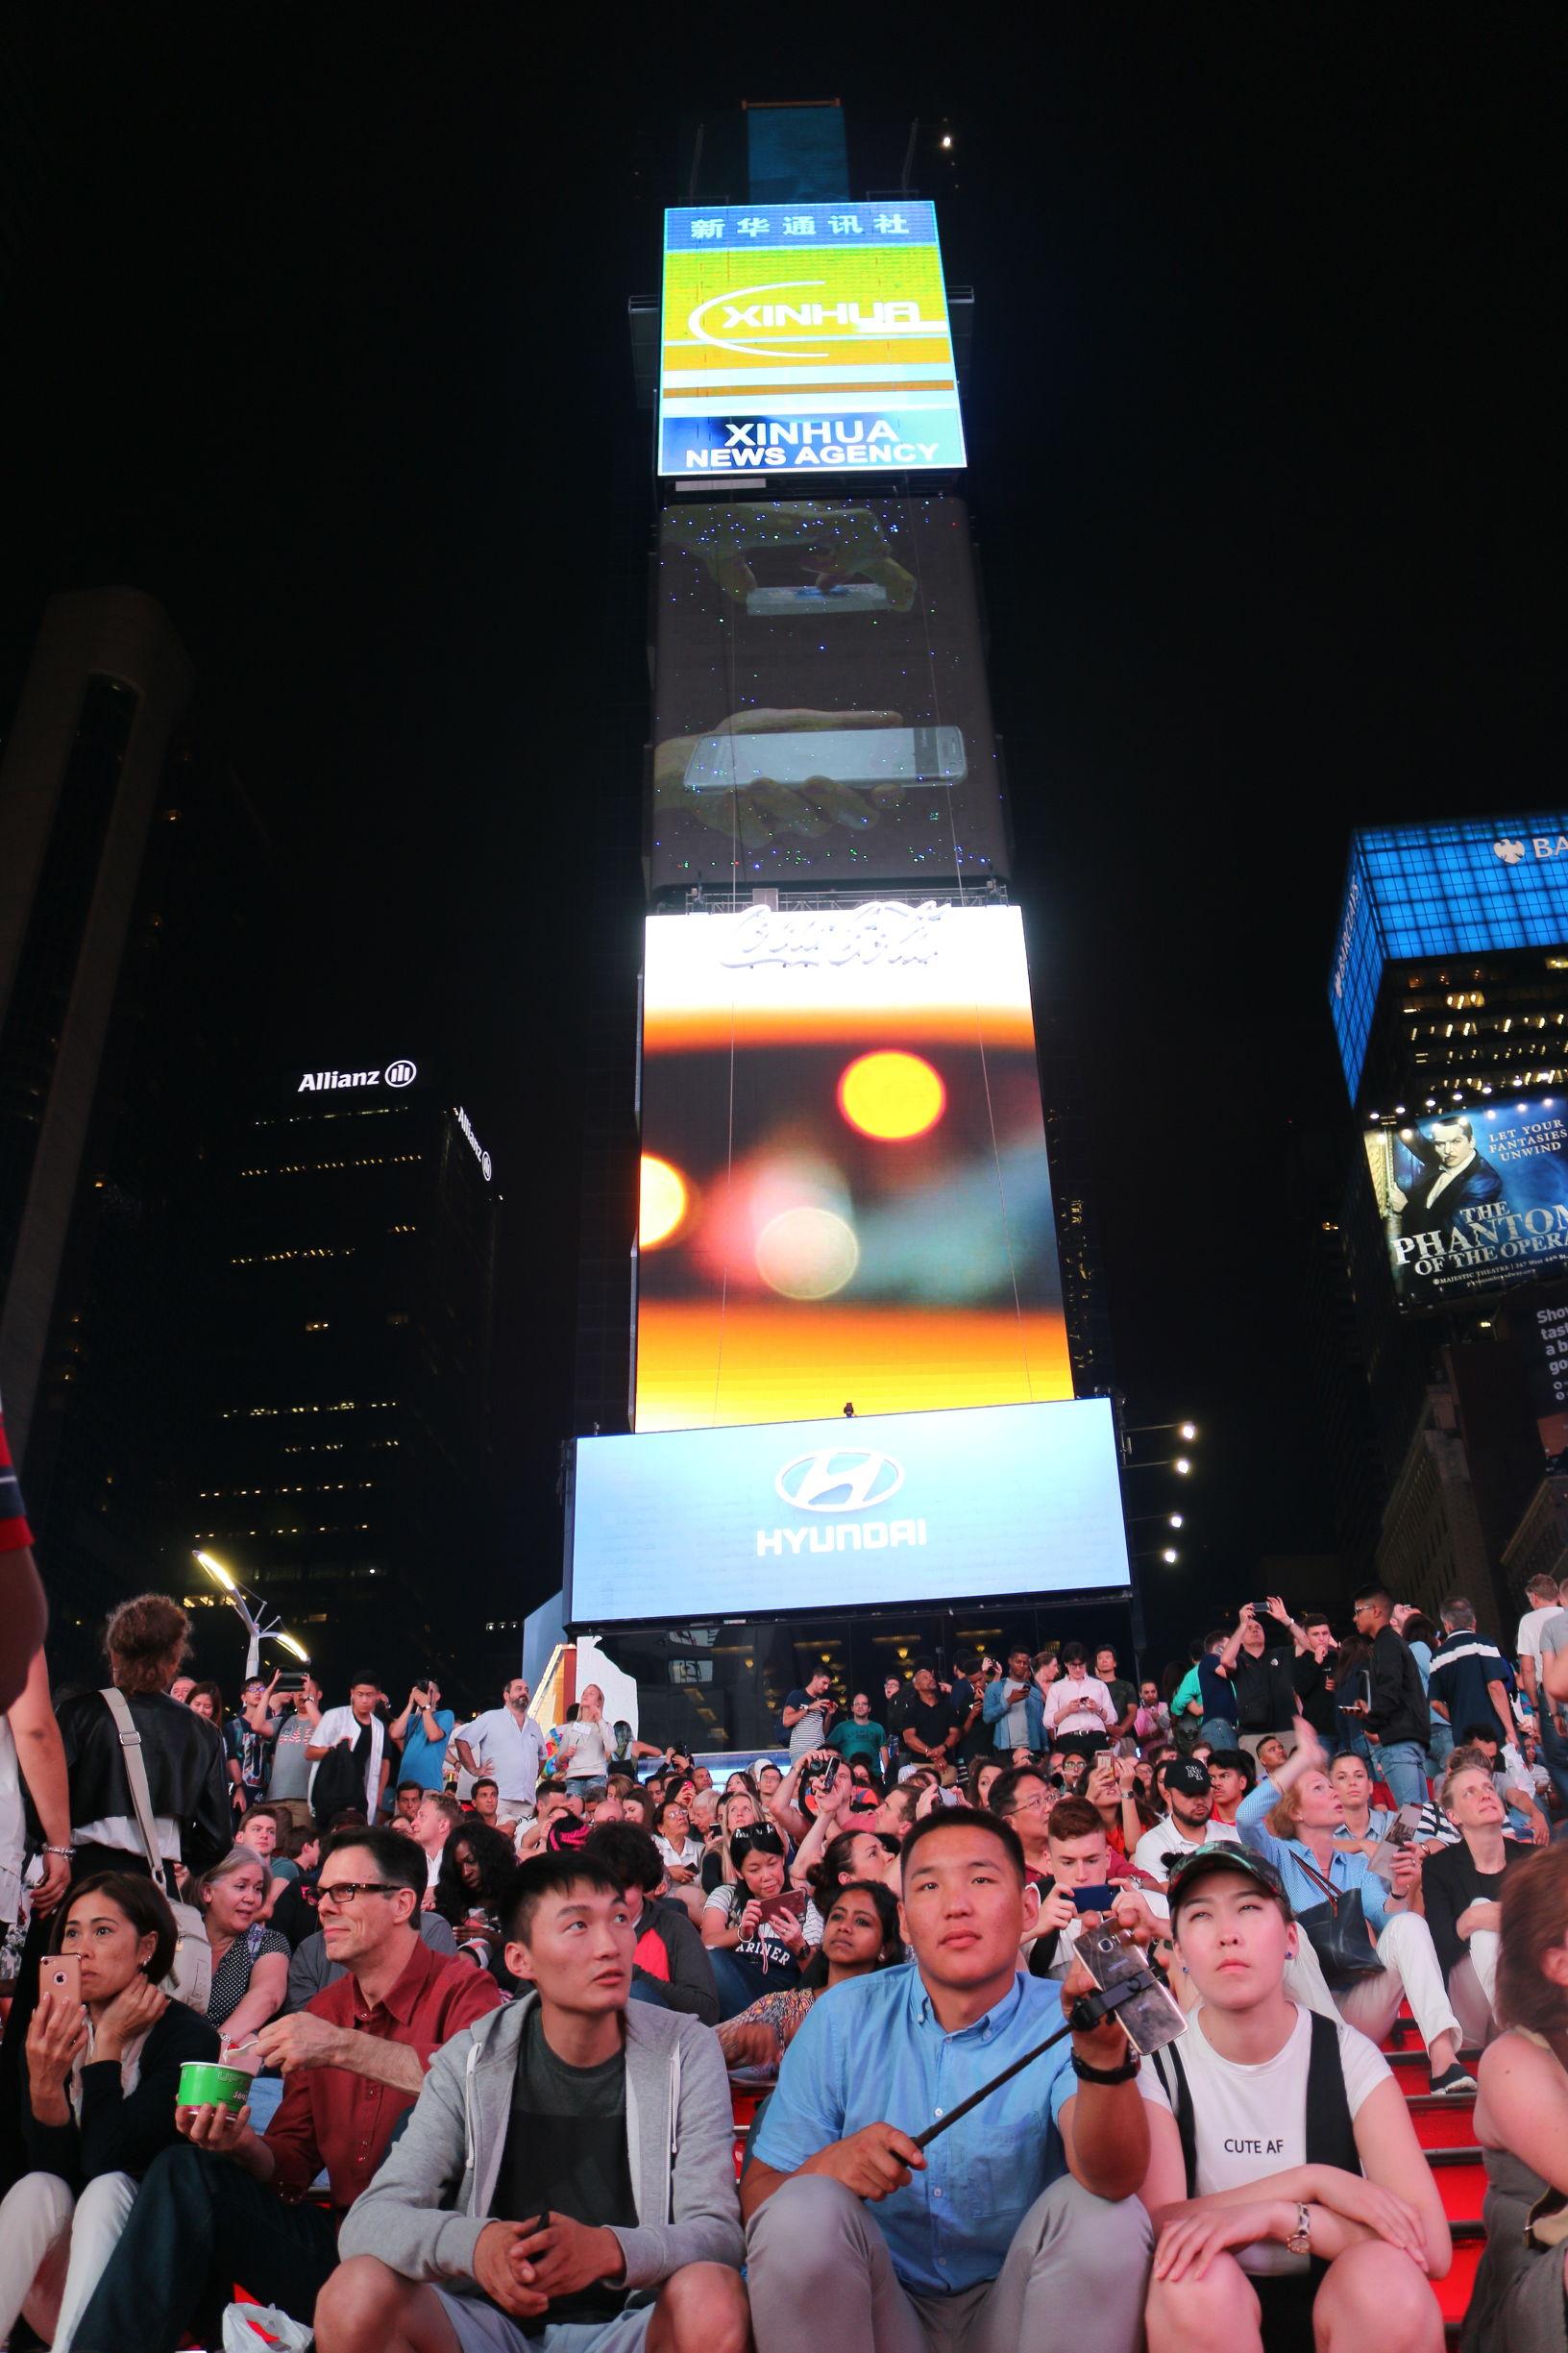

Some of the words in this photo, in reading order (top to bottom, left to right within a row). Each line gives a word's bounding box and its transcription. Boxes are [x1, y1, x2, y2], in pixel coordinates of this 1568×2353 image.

[691, 213, 910, 239] 新华通讯社
[724, 420, 900, 447] XINHUA
[685, 446, 787, 468] NEWS
[795, 442, 940, 465] AGENCY
[297, 1069, 380, 1092] Allianz
[457, 1106, 482, 1163] Allianz
[1489, 1129, 1516, 1142] LET
[1522, 1119, 1564, 1135] YOUR
[1489, 1128, 1568, 1154] FANTASIES
[1499, 1141, 1562, 1162] UNWIND
[1459, 1201, 1511, 1224] THE
[1414, 1258, 1445, 1276] OF
[1449, 1245, 1499, 1268] THE
[1500, 1229, 1568, 1259] OPER
[1545, 1344, 1556, 1356] a
[756, 1518, 927, 1556] HYUNDAI
[1224, 2139, 1262, 2154] CUTE
[1266, 2139, 1284, 2154] AF
